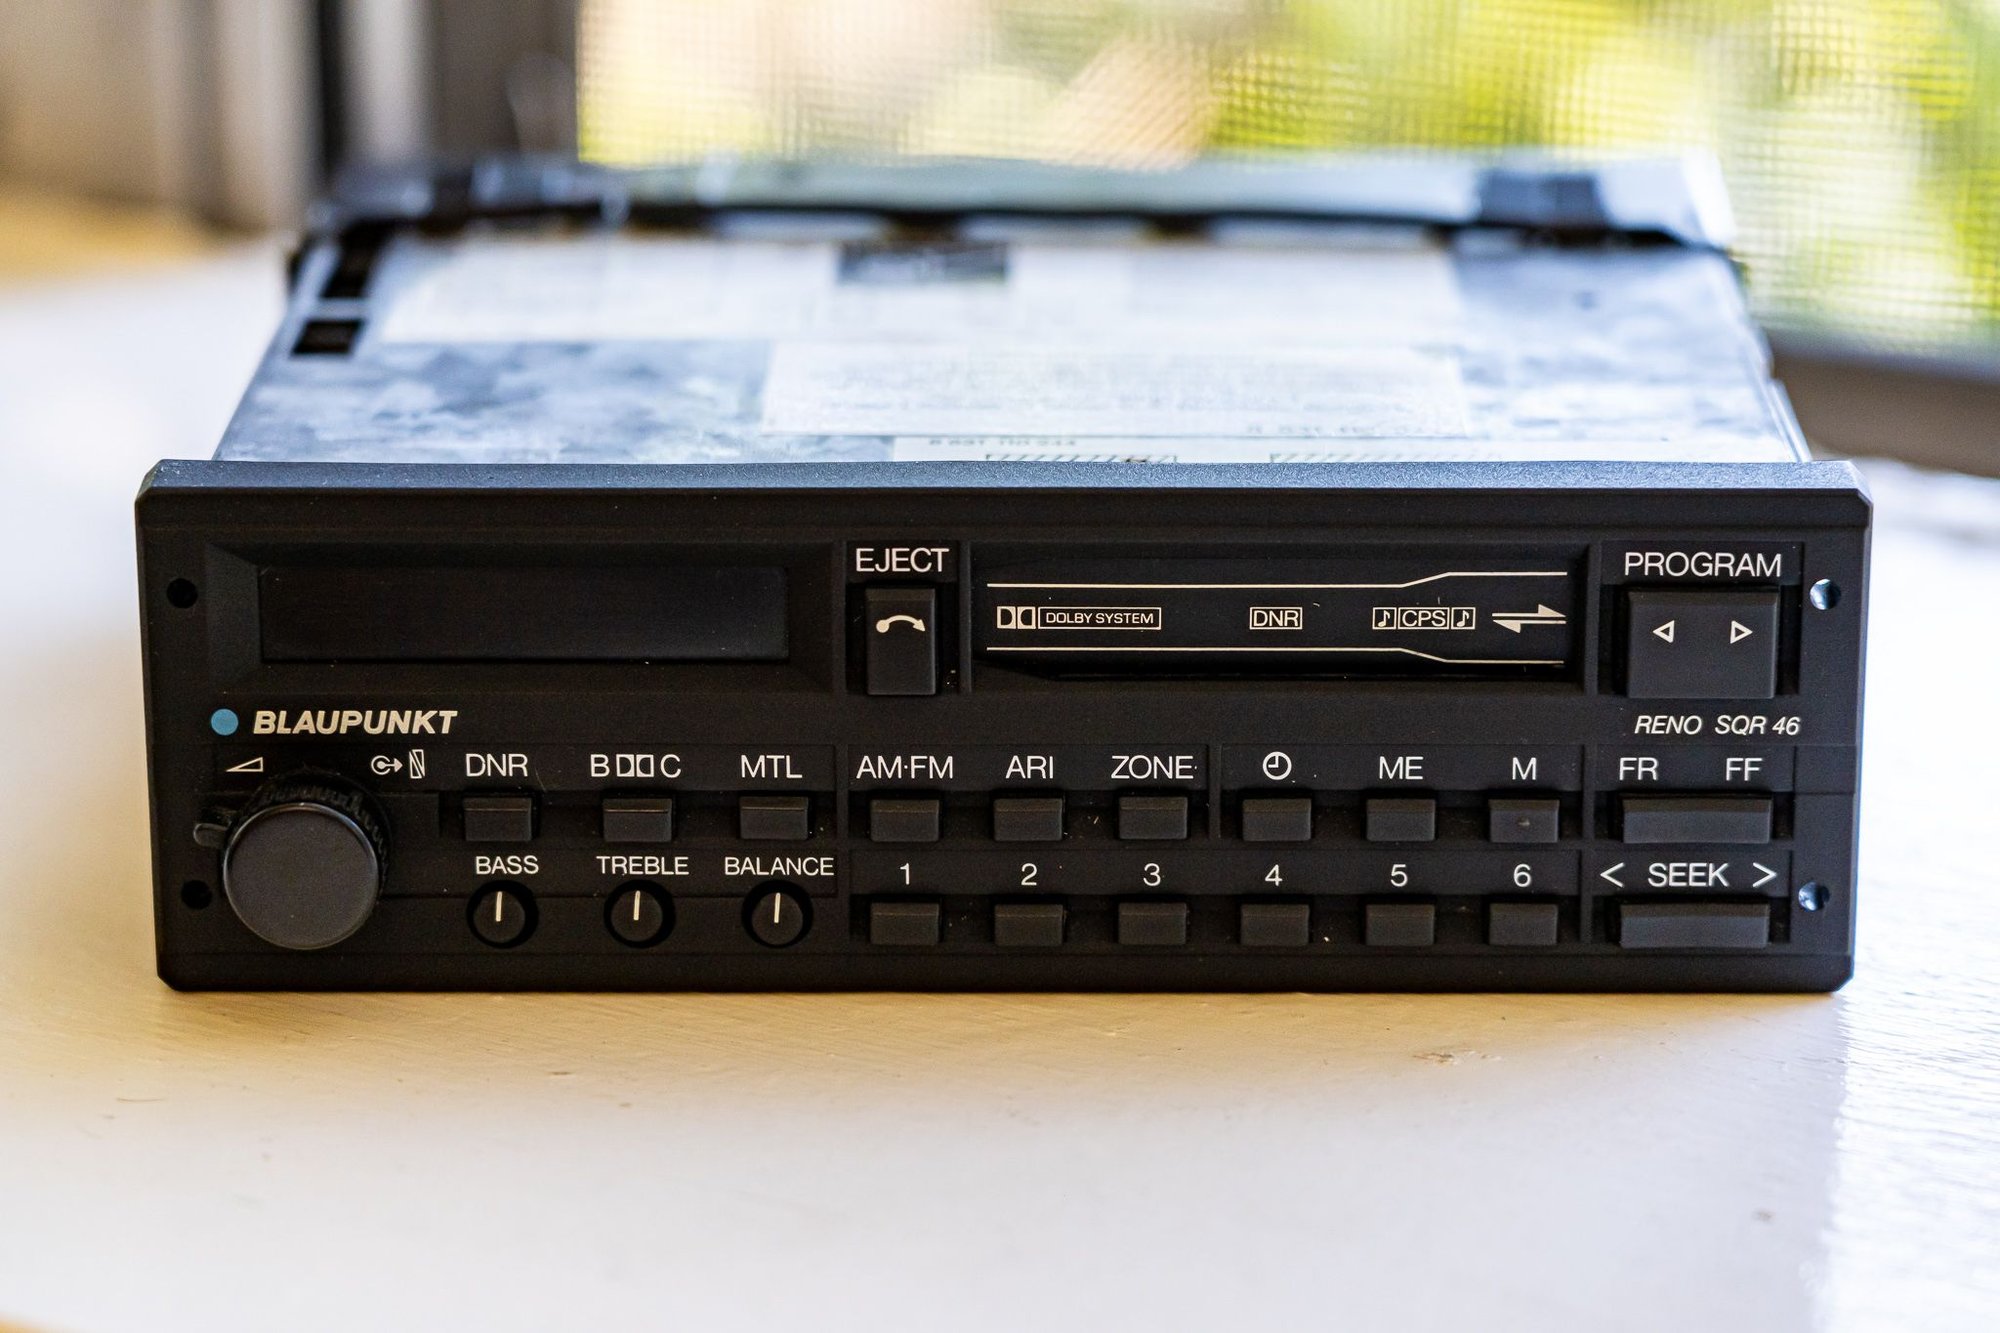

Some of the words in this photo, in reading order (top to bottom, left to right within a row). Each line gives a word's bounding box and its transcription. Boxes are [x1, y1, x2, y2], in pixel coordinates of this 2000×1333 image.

[855, 547, 950, 573] EJECT
[1624, 551, 1782, 577] PROGRAM
[1045, 612, 1093, 624] DOLBY
[1095, 612, 1154, 624] SYSTEM
[1253, 609, 1299, 627] DNR
[1401, 609, 1446, 627] CPS
[253, 710, 458, 735] BLAUPUNKT
[1634, 714, 1703, 735] RENO
[1714, 714, 1768, 737] SQR
[1771, 716, 1802, 736] 46
[465, 753, 528, 777] DNR
[740, 754, 803, 779] MTL
[1005, 755, 1054, 779] ARI
[1110, 755, 1194, 780] ZONE
[1379, 755, 1424, 780] ME
[1511, 756, 1537, 781] M
[1619, 756, 1659, 781] FR
[1725, 757, 1764, 782] FF
[475, 855, 540, 875] BASS
[596, 856, 690, 876] TREBLE
[724, 856, 835, 877] BALANCE
[899, 862, 911, 885] 1
[1020, 862, 1038, 886] 2
[1143, 862, 1161, 887] 3
[1264, 864, 1283, 887] 4
[1390, 863, 1408, 887] 5
[1513, 863, 1532, 888] 6
[1647, 862, 1730, 888] SEEK
